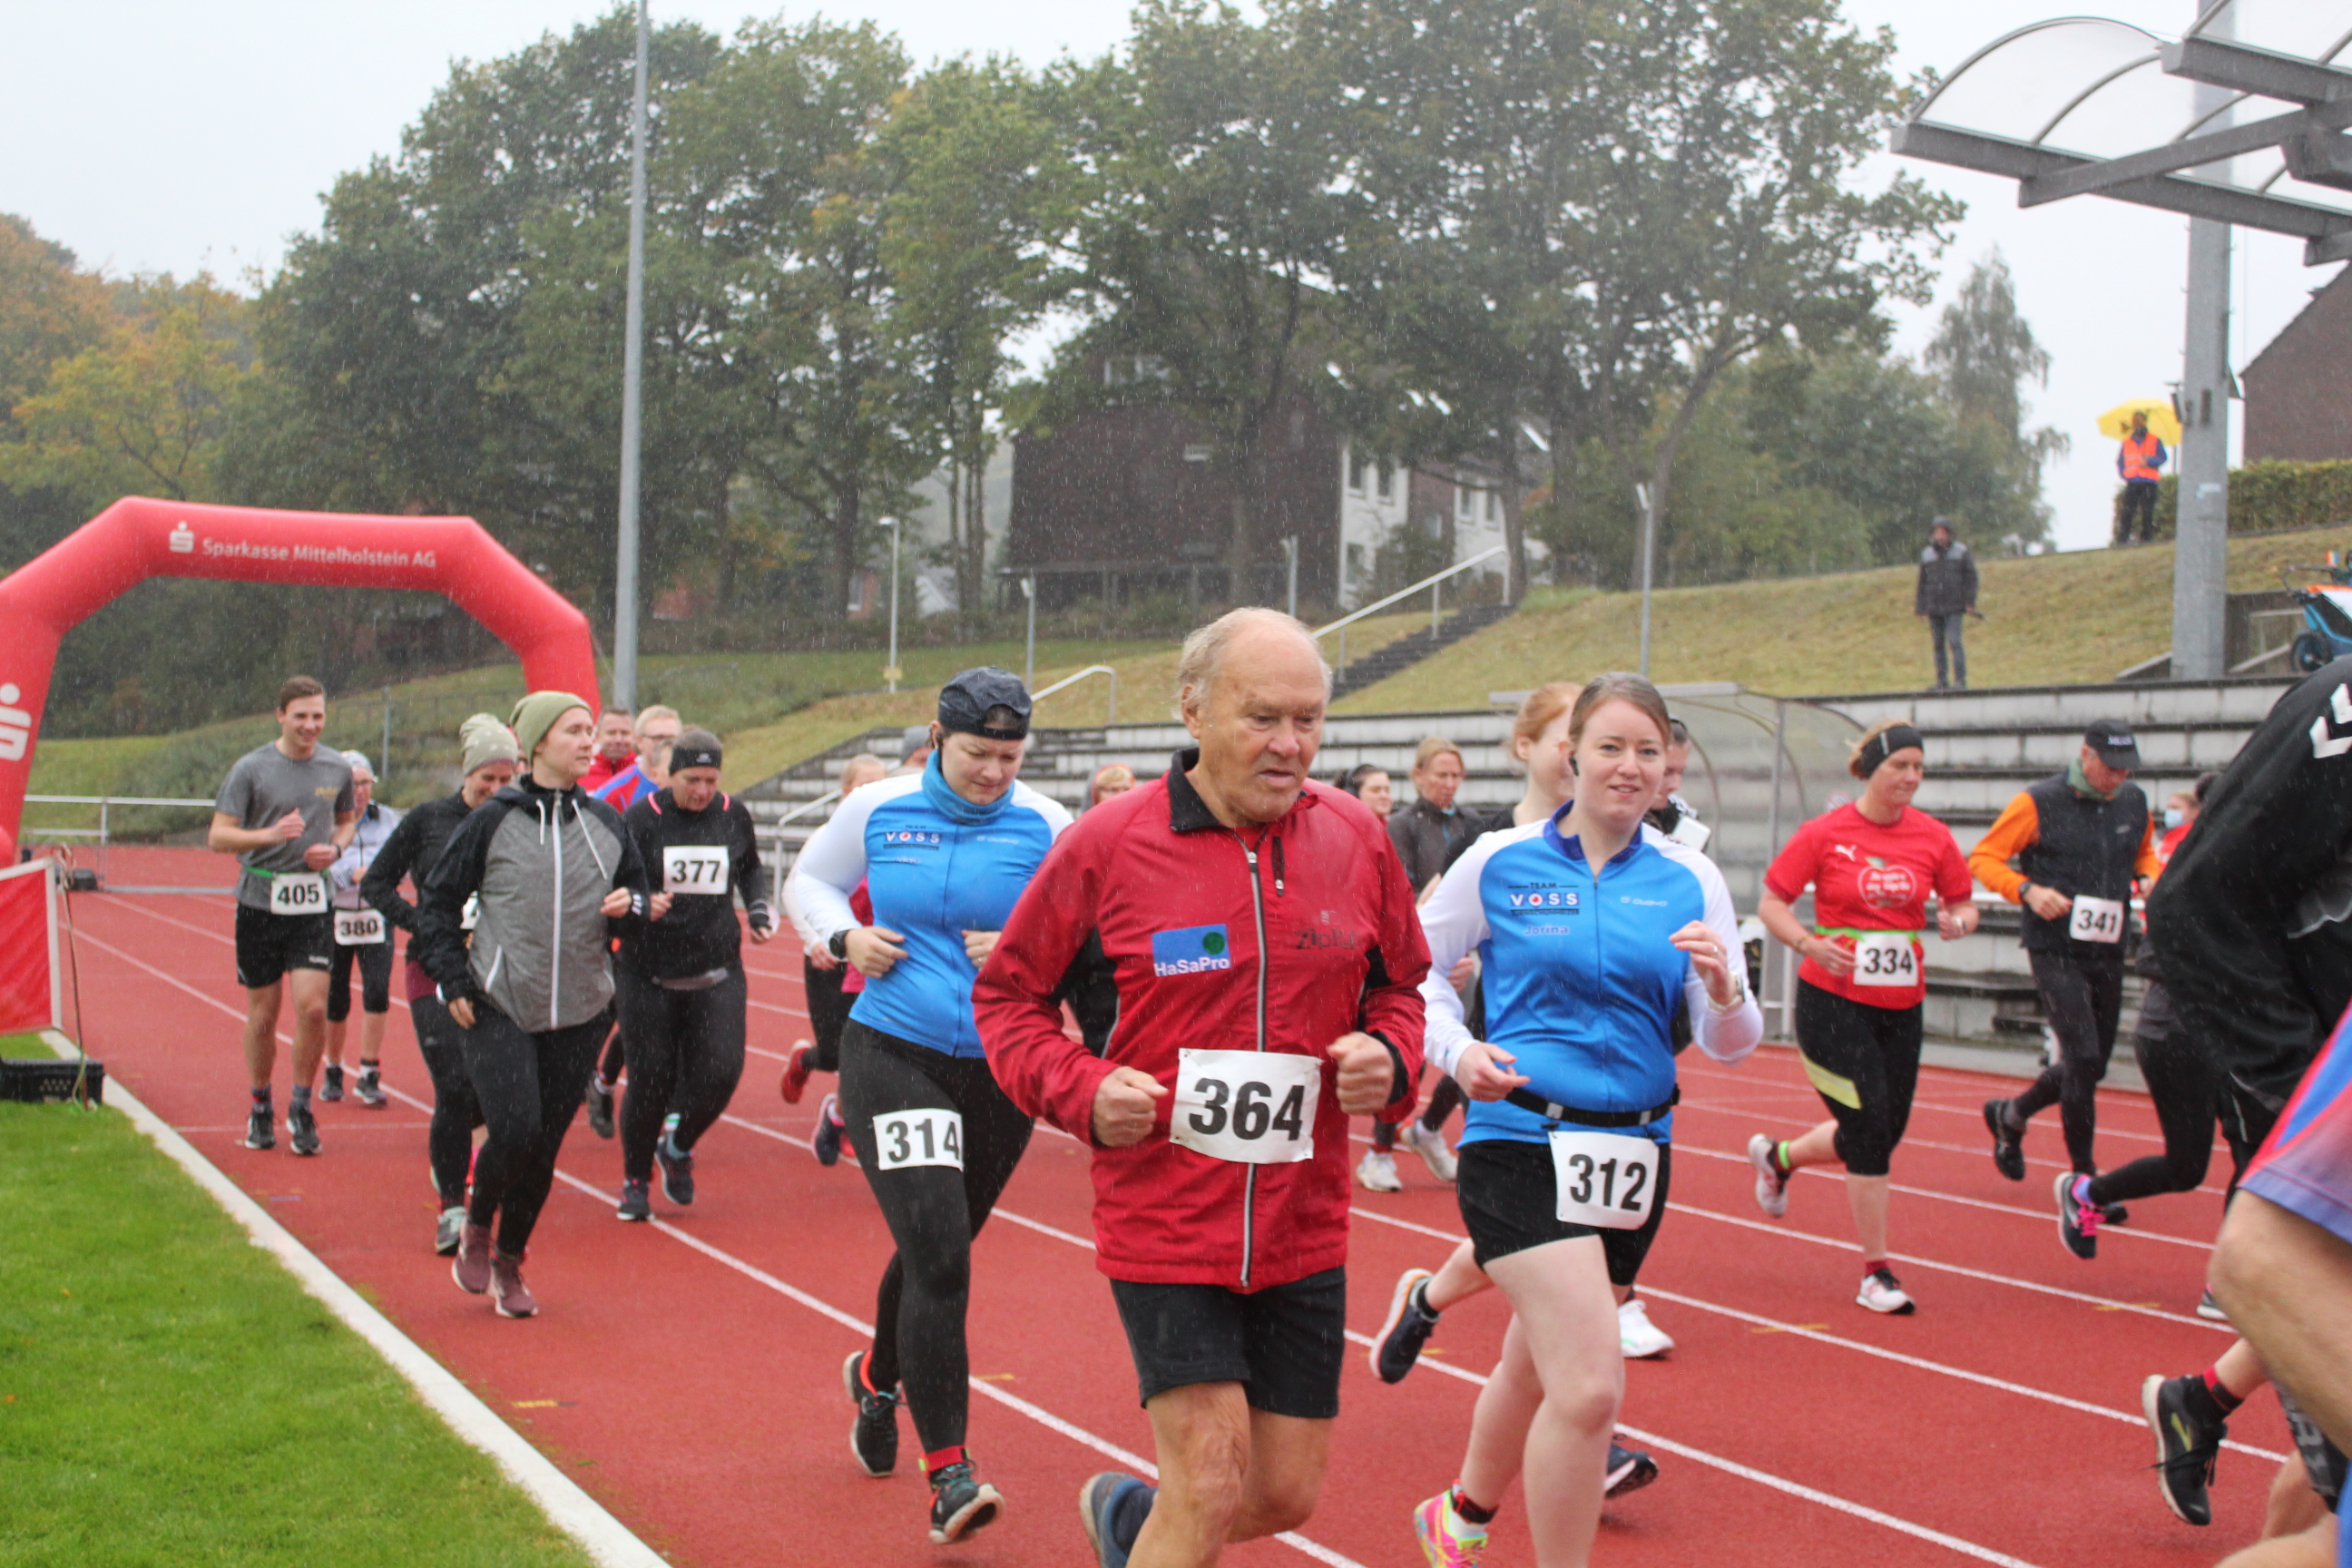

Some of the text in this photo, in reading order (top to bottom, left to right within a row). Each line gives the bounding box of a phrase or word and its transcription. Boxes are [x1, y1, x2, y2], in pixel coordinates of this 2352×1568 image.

[202, 537, 289, 562] Sparkasse
[293, 544, 409, 567] Mittelholstein
[411, 550, 436, 568] AG
[885, 831, 942, 845] VOSS
[671, 859, 721, 884] 377
[277, 884, 320, 906] 405
[1530, 882, 1558, 890] TEAM
[1510, 892, 1579, 907] VOSS
[339, 918, 378, 936] 380
[1524, 924, 1571, 936] Jorina
[2078, 908, 2117, 934] 341
[1153, 956, 1230, 977] HaSaPro
[1864, 947, 1913, 975] 334
[1189, 1076, 1305, 1142] 364
[886, 1118, 960, 1163] 314
[1568, 1153, 1648, 1212] 312
